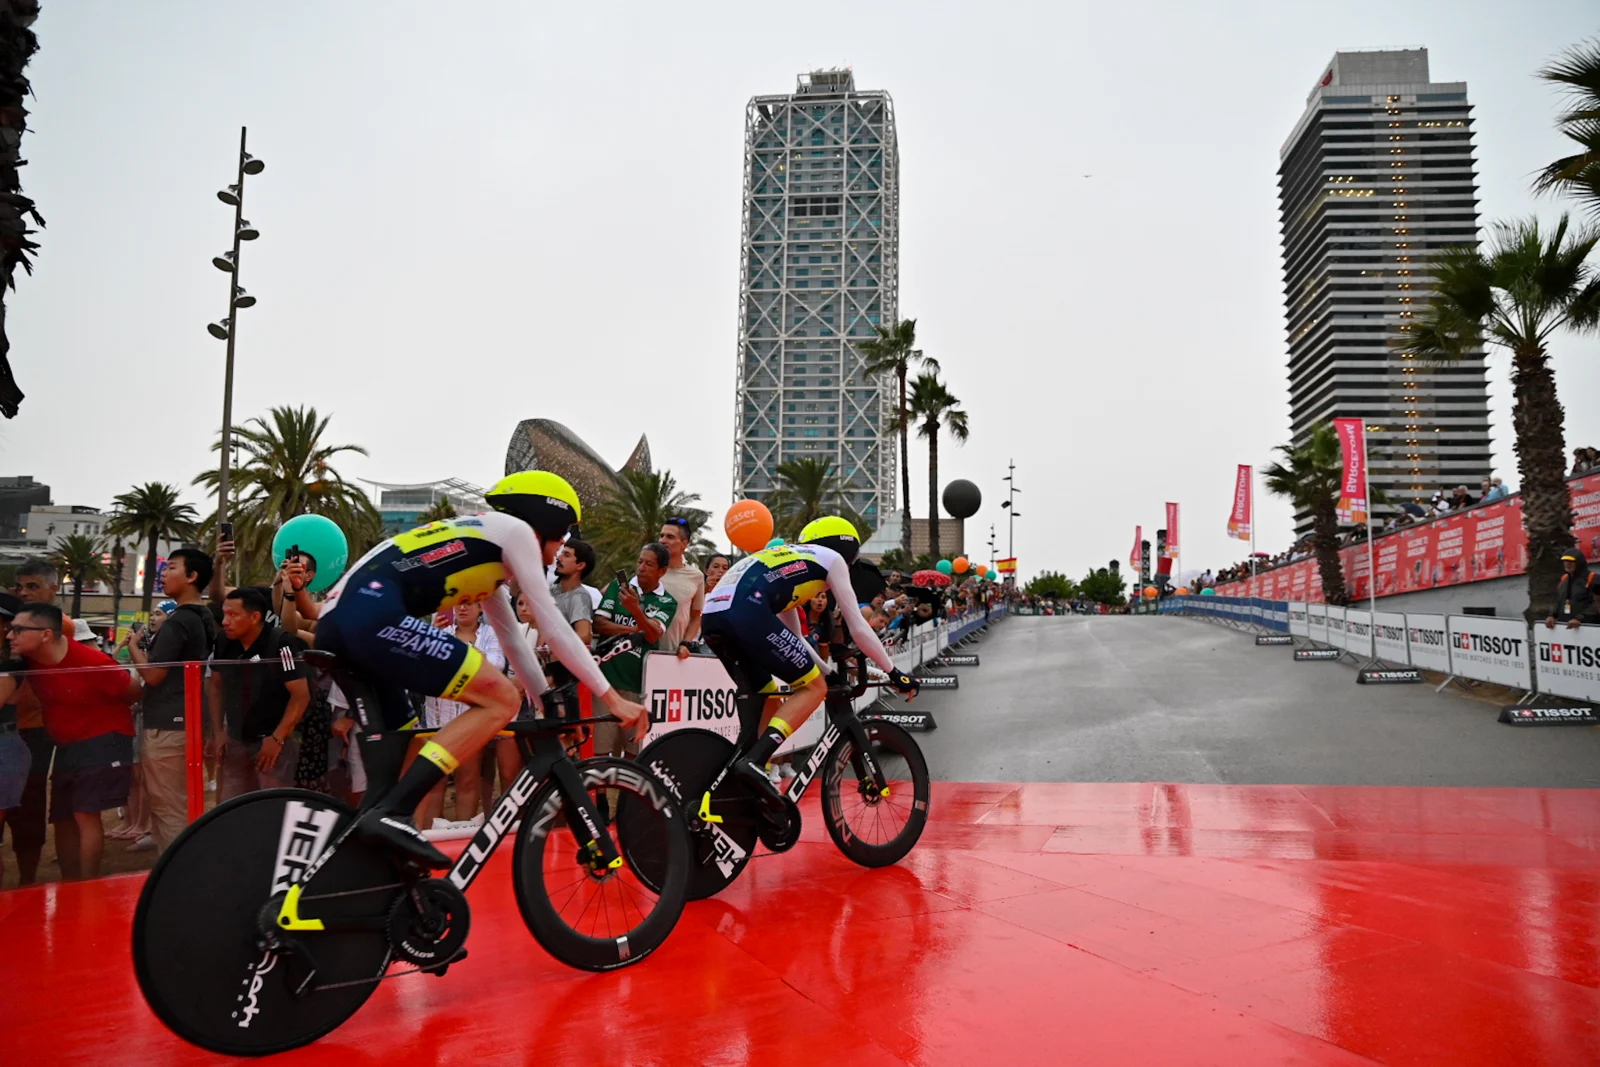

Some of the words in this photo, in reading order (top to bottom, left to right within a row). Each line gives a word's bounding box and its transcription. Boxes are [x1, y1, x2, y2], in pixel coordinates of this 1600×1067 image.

[1420, 628, 1444, 646] TISSOT
[1470, 634, 1522, 657] TISSOT
[684, 688, 738, 721] TISSO
[1532, 708, 1593, 717] TISSOT
[787, 724, 841, 803] CUBE
[449, 769, 540, 892] CUBE
[577, 806, 601, 839] CUBE
[302, 845, 336, 882] CUBE
